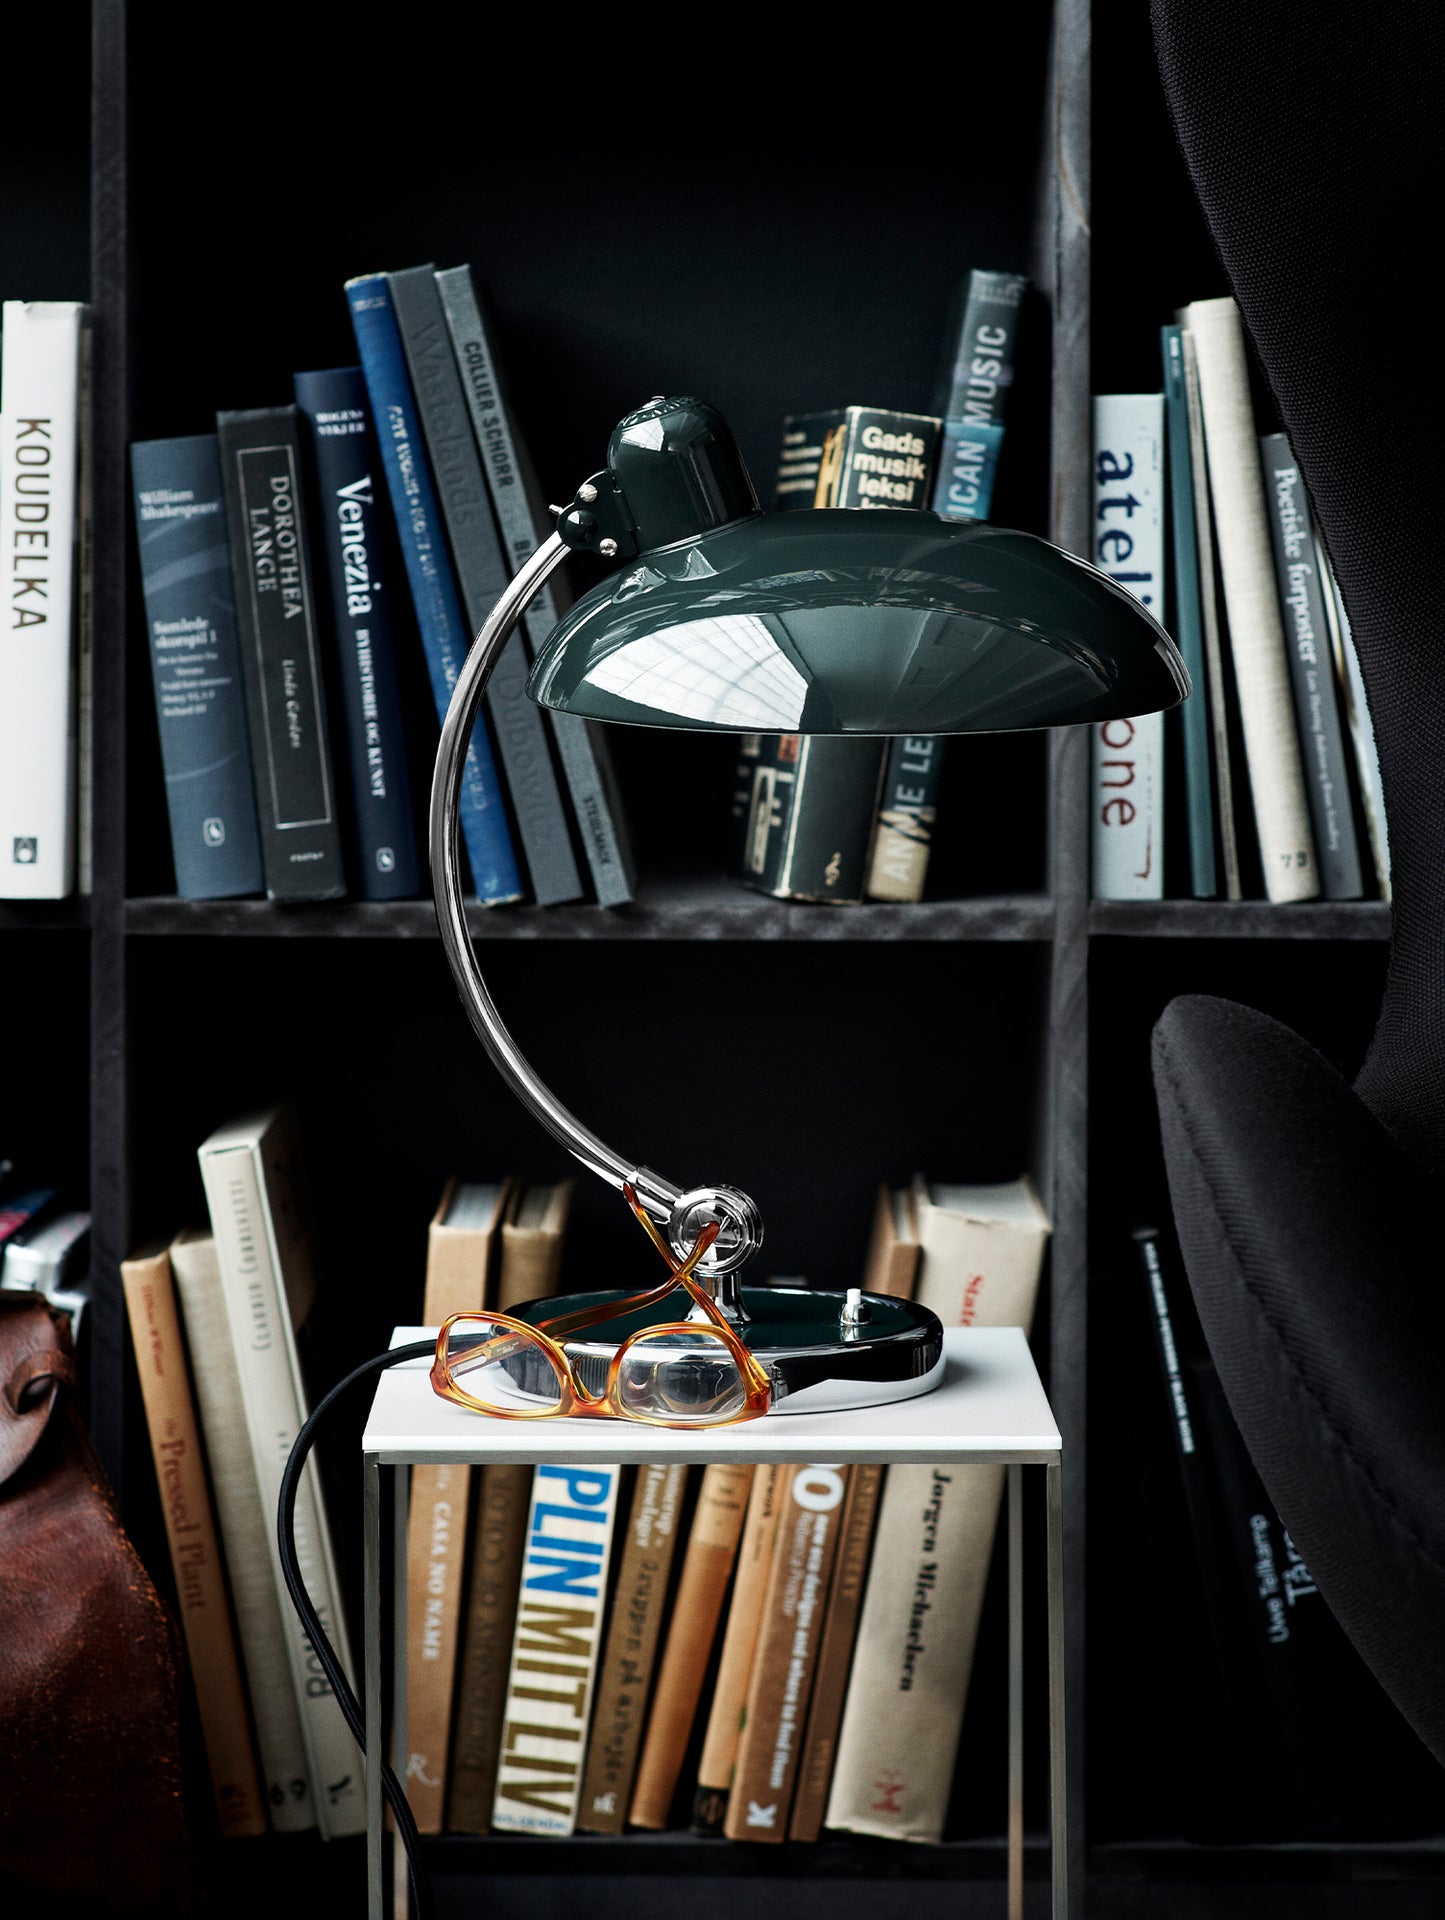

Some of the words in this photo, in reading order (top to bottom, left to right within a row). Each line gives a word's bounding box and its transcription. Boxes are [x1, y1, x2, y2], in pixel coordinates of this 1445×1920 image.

[962, 325, 1007, 429] MUSIC
[464, 341, 494, 411] COLLIER
[482, 410, 514, 488] SCHORR
[513, 539, 542, 612] BLEN
[853, 452, 926, 480] musik
[857, 473, 915, 502] leksi
[861, 425, 925, 456] Gads
[12, 418, 52, 629] KOUDELKA
[250, 507, 277, 592] LANGE
[270, 475, 303, 619] DOROTHEA
[337, 474, 382, 616] Venezia
[1098, 448, 1152, 606] atel
[1274, 466, 1298, 559] Poetiske
[1285, 560, 1316, 665] forposter
[160, 1439, 201, 1536] Pressed
[431, 1501, 452, 1557] CASA
[525, 1464, 613, 1598] PLIN
[177, 1538, 206, 1610] Plant
[428, 1561, 447, 1595] NO
[1250, 1514, 1279, 1599] Tellkamp
[422, 1597, 445, 1661] NAME
[511, 1602, 595, 1719] MIT
[500, 1721, 580, 1816] LIV
